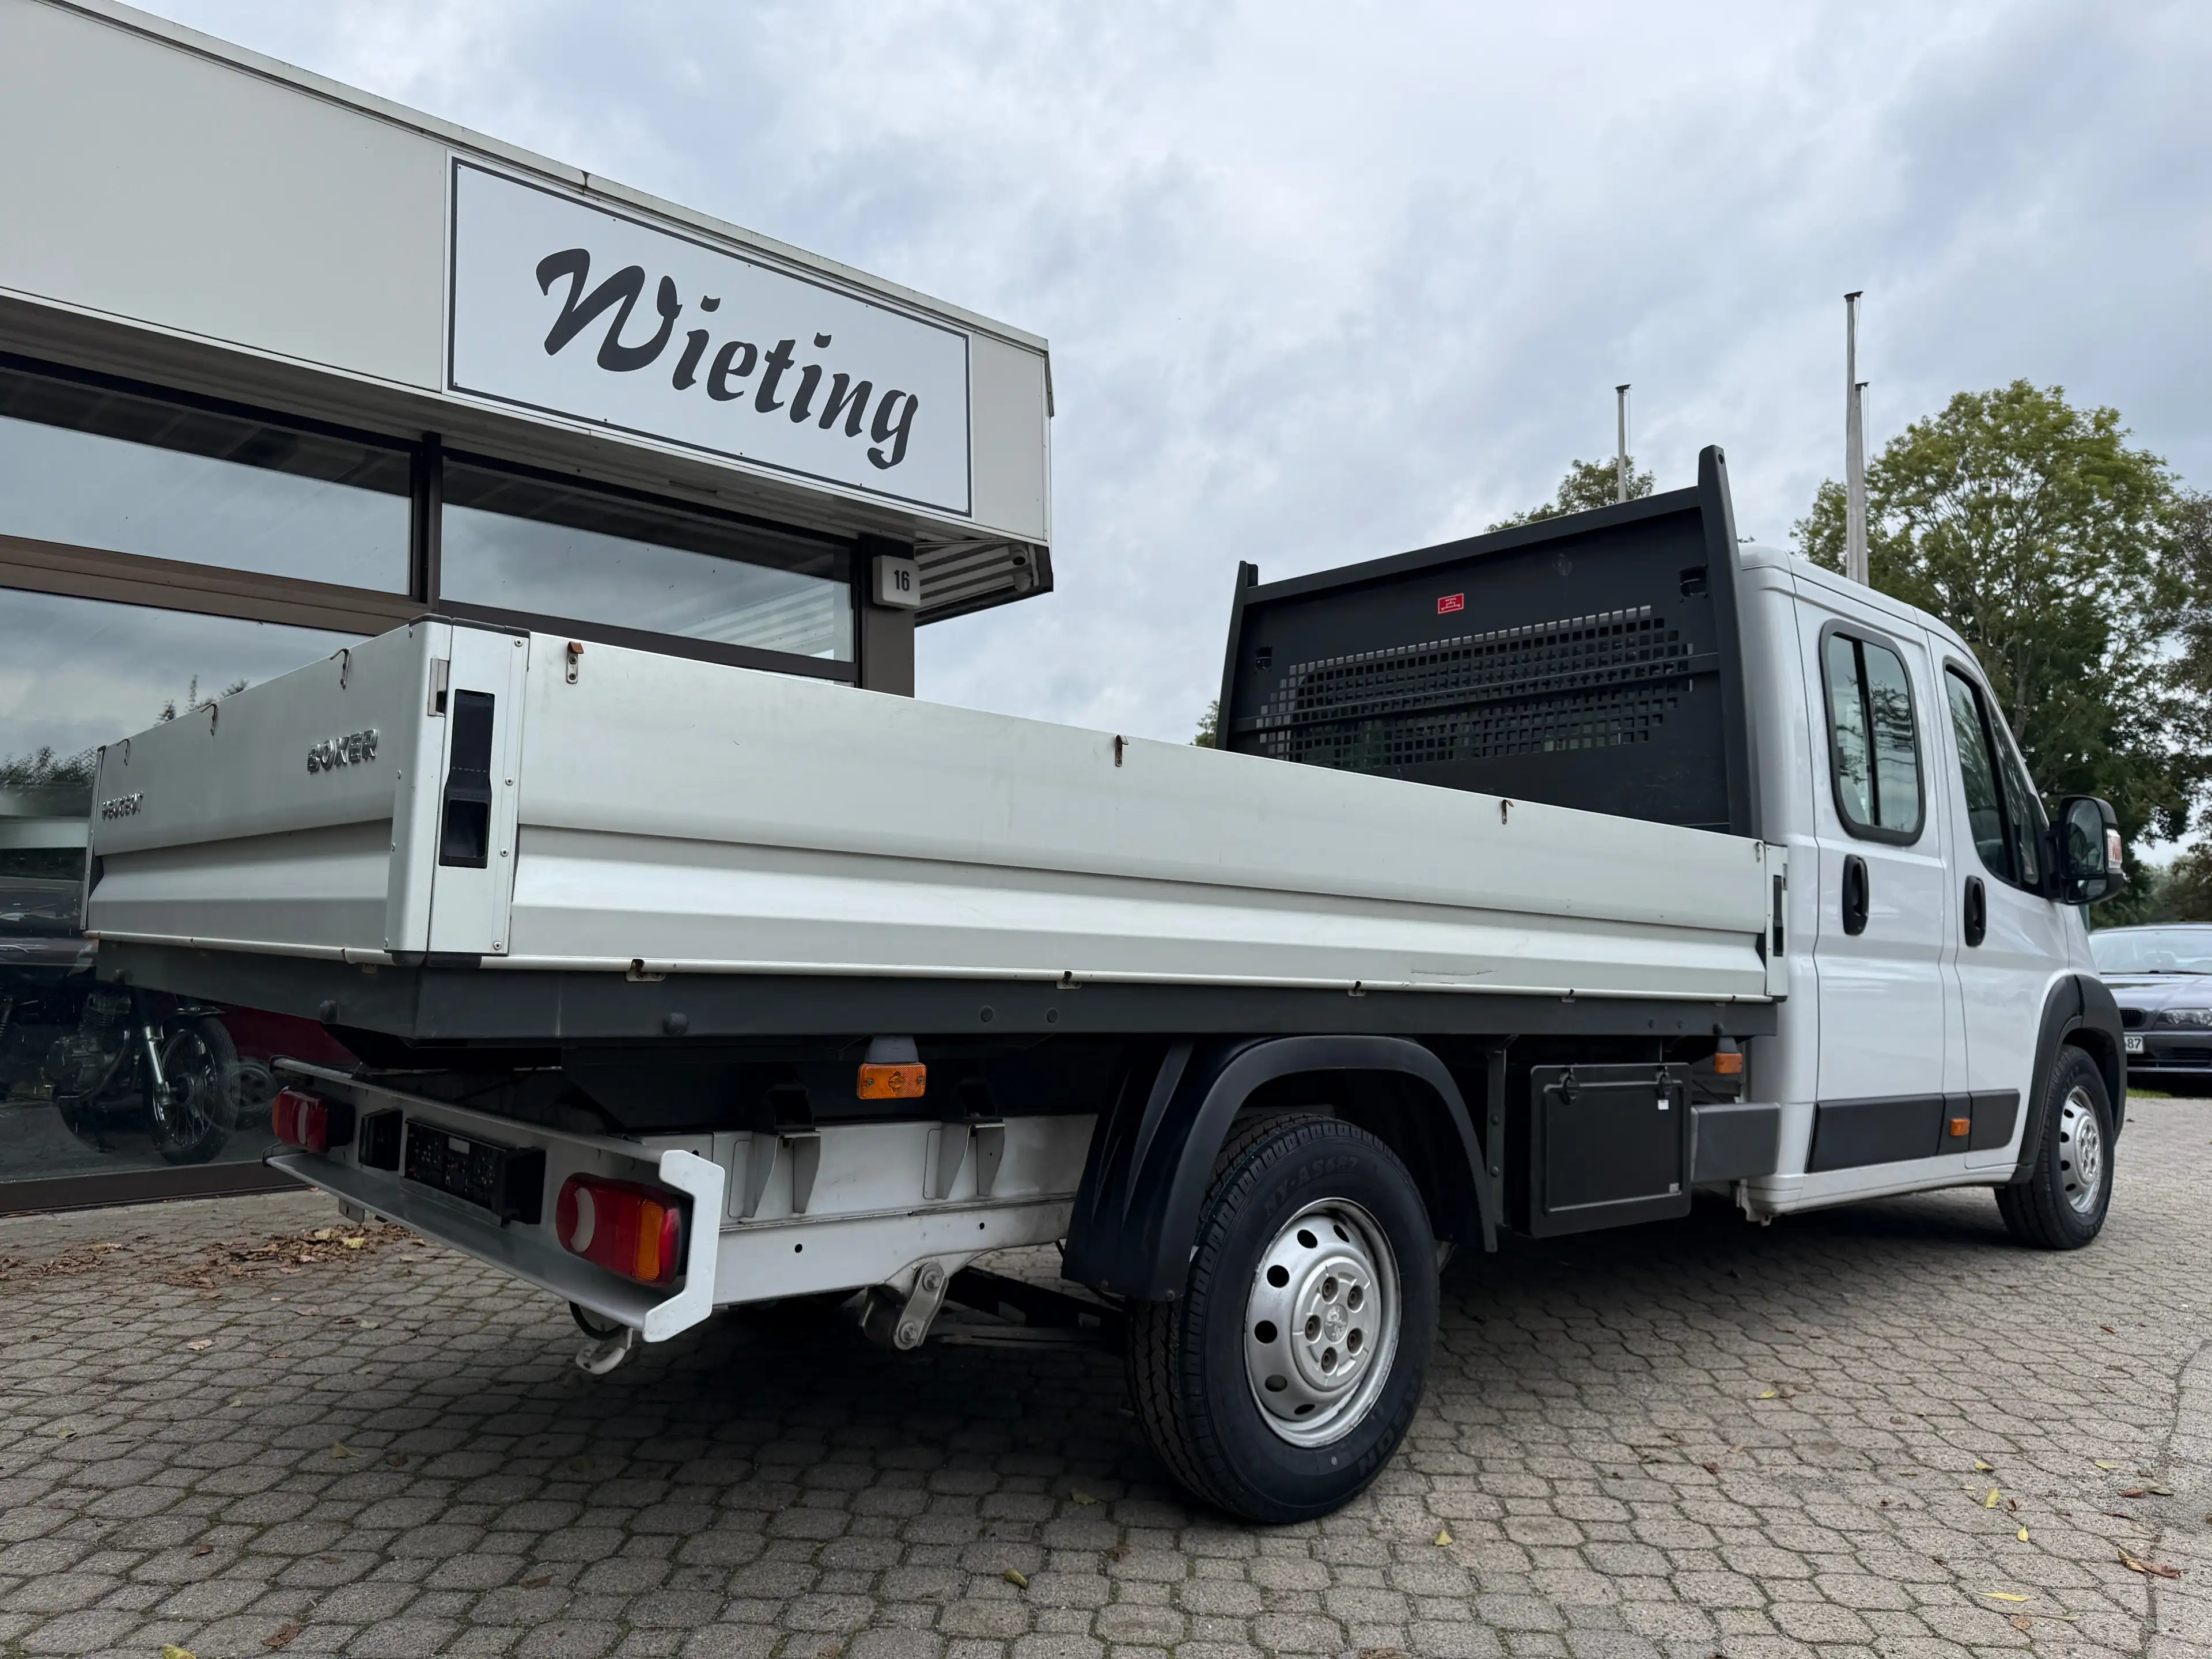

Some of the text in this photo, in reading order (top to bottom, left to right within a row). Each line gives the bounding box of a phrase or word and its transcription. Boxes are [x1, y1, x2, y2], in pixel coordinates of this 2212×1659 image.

[536, 248, 918, 470] Wieting
[894, 569, 910, 592] 16
[307, 728, 378, 772] BOXER
[2127, 1038, 2141, 1050] 87
